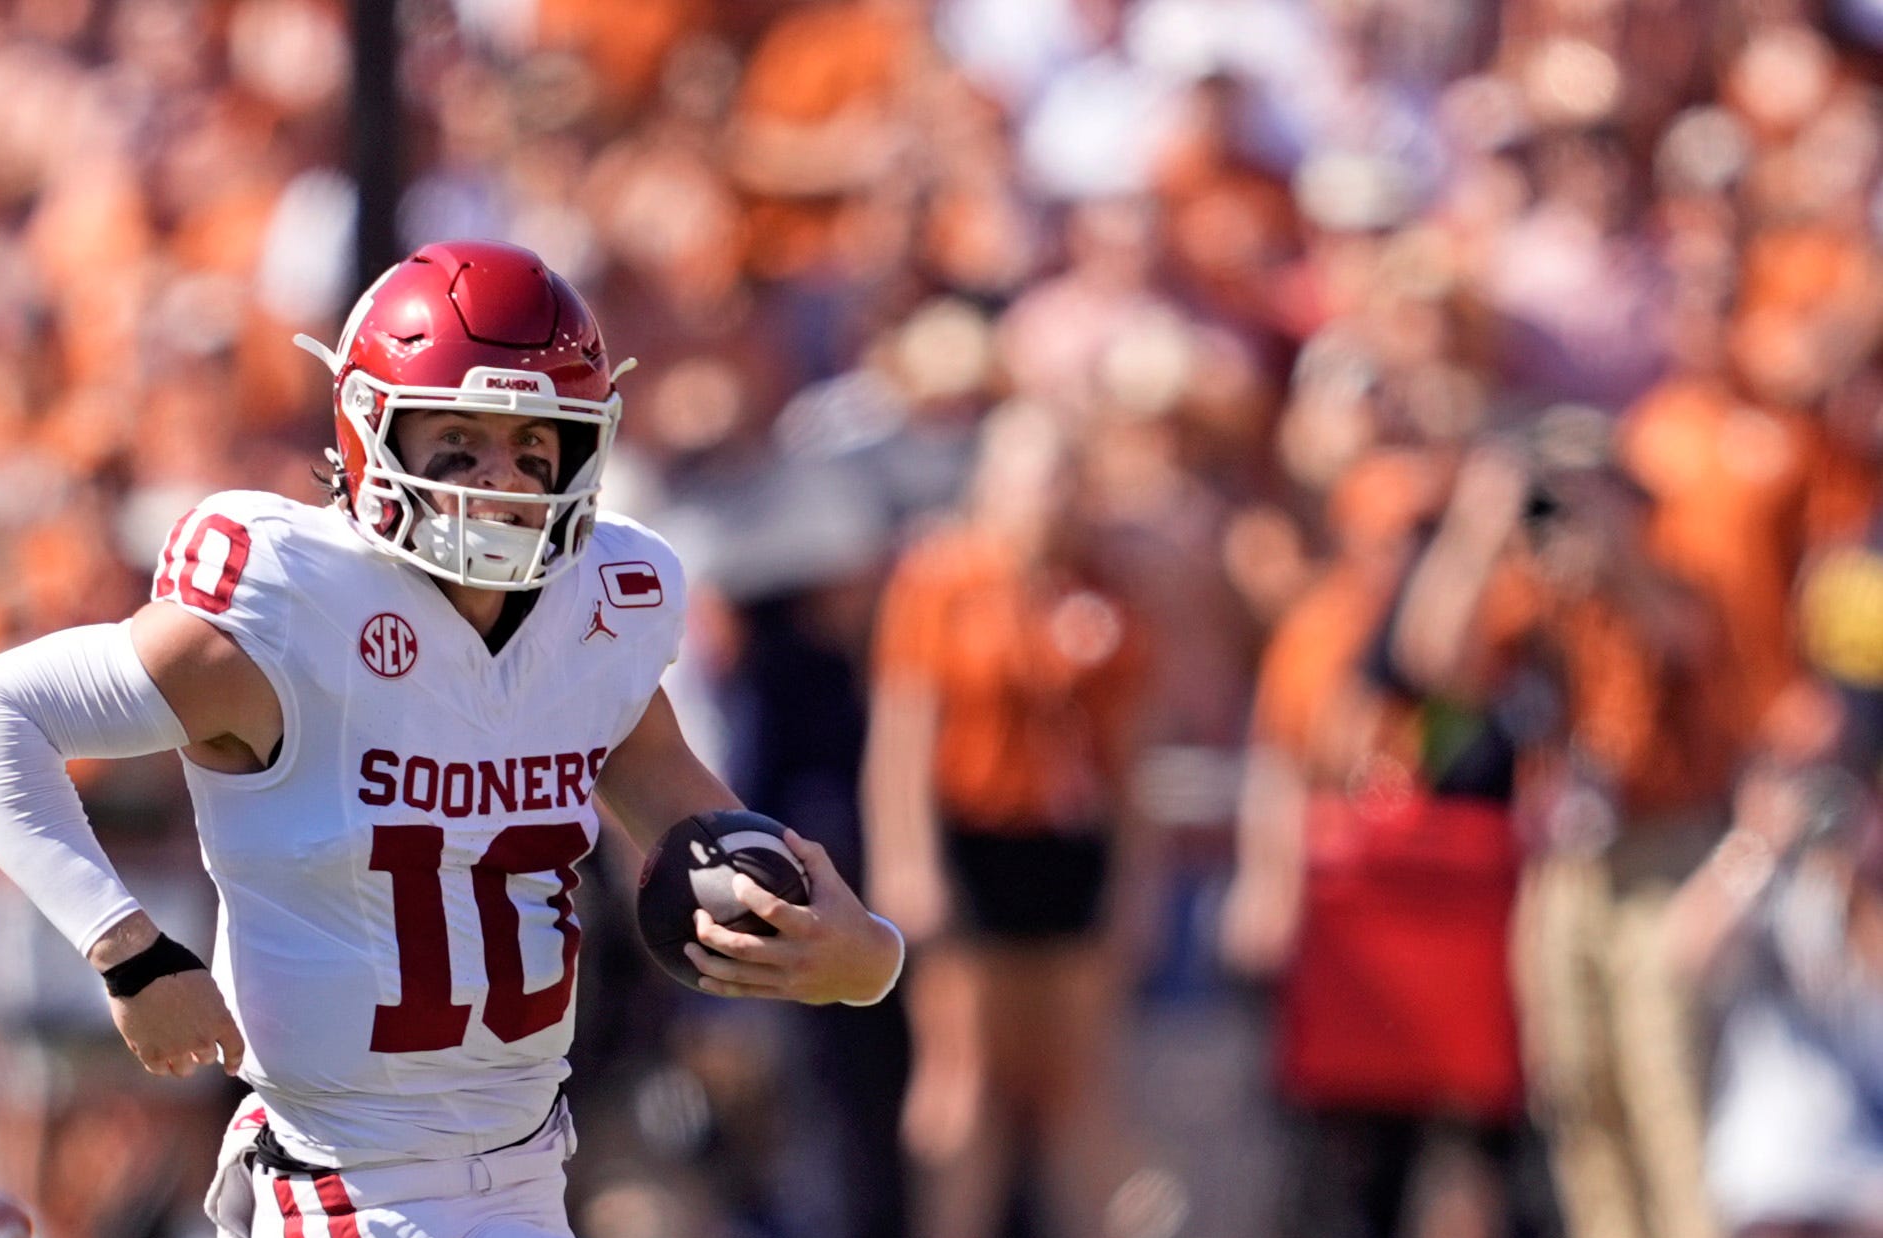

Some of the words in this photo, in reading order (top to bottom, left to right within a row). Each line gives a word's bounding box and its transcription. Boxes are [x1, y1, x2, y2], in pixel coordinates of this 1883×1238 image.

[156, 508, 251, 615] 10
[363, 613, 416, 677] SEC
[369, 822, 591, 1053] 10
